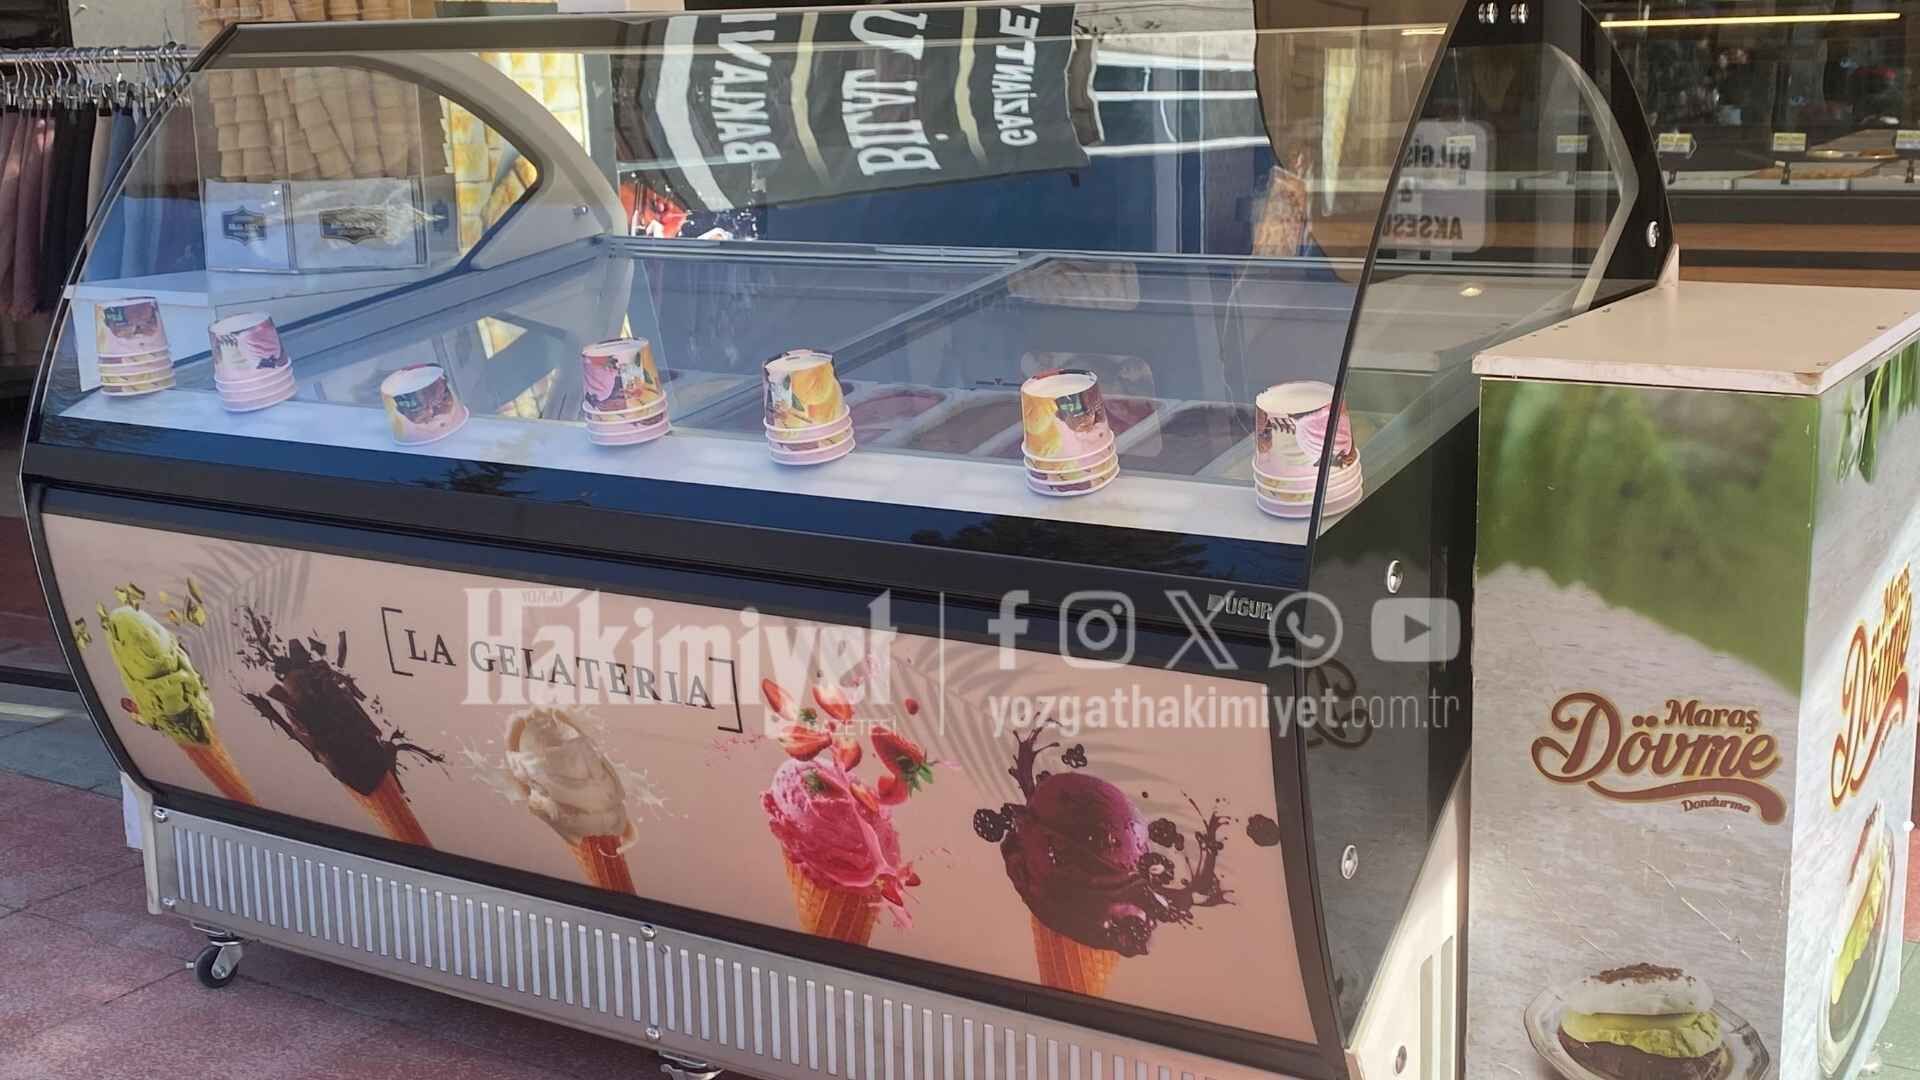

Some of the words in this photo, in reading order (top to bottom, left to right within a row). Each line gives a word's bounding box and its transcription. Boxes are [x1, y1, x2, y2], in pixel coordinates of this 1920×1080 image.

[404, 629, 456, 667] LA
[470, 640, 716, 710] GELATERIA
[1531, 692, 1783, 784] Dövme
[1664, 699, 1760, 735] Maraş
[1681, 797, 1751, 814] Dondurma
